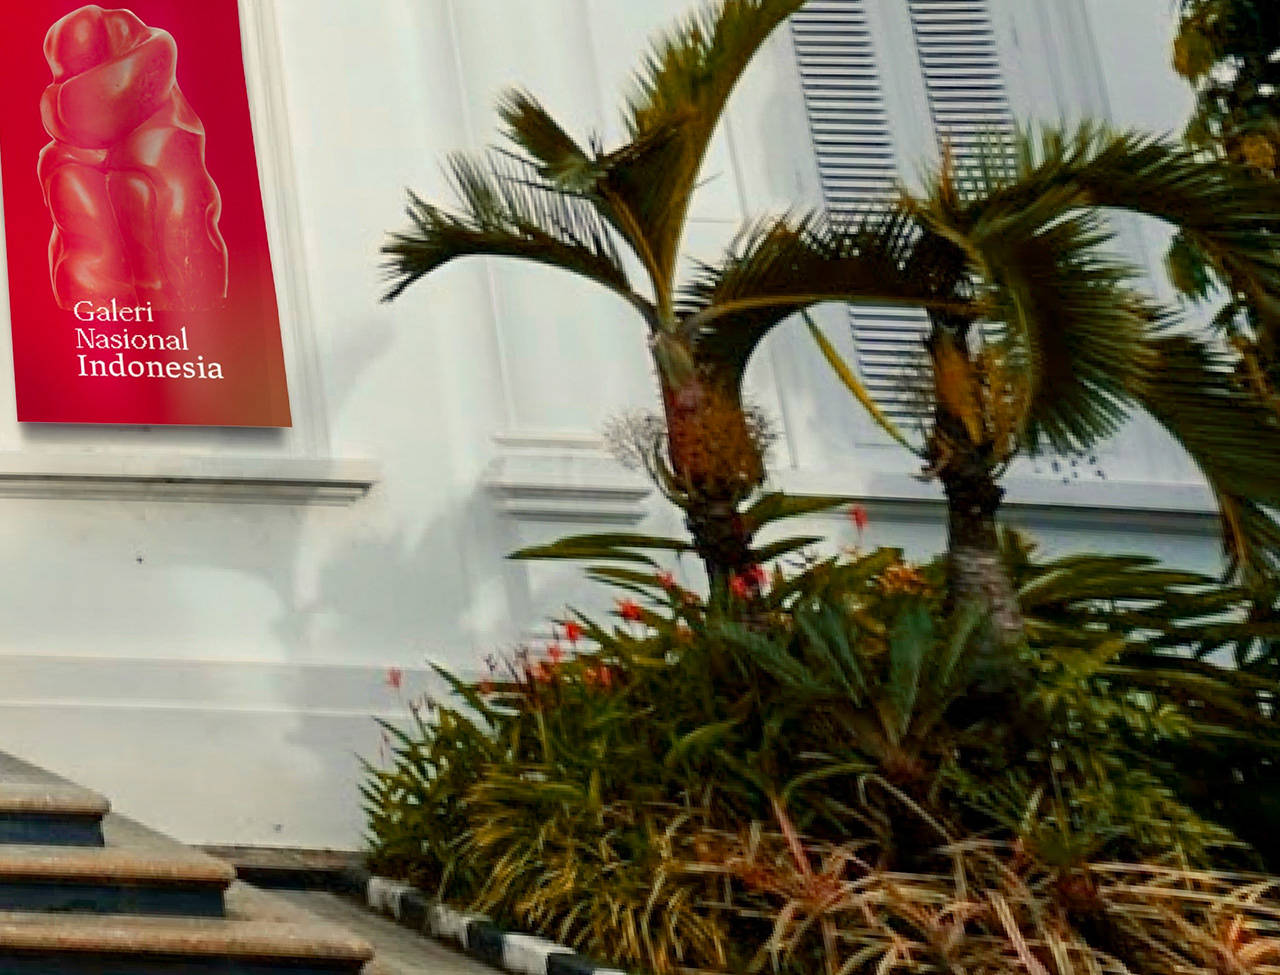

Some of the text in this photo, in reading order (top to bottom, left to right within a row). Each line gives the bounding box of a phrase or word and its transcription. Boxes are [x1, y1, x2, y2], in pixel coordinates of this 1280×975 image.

[73, 297, 154, 322] Galeri
[75, 326, 189, 351] Nasional
[77, 352, 225, 379] Indonesia
